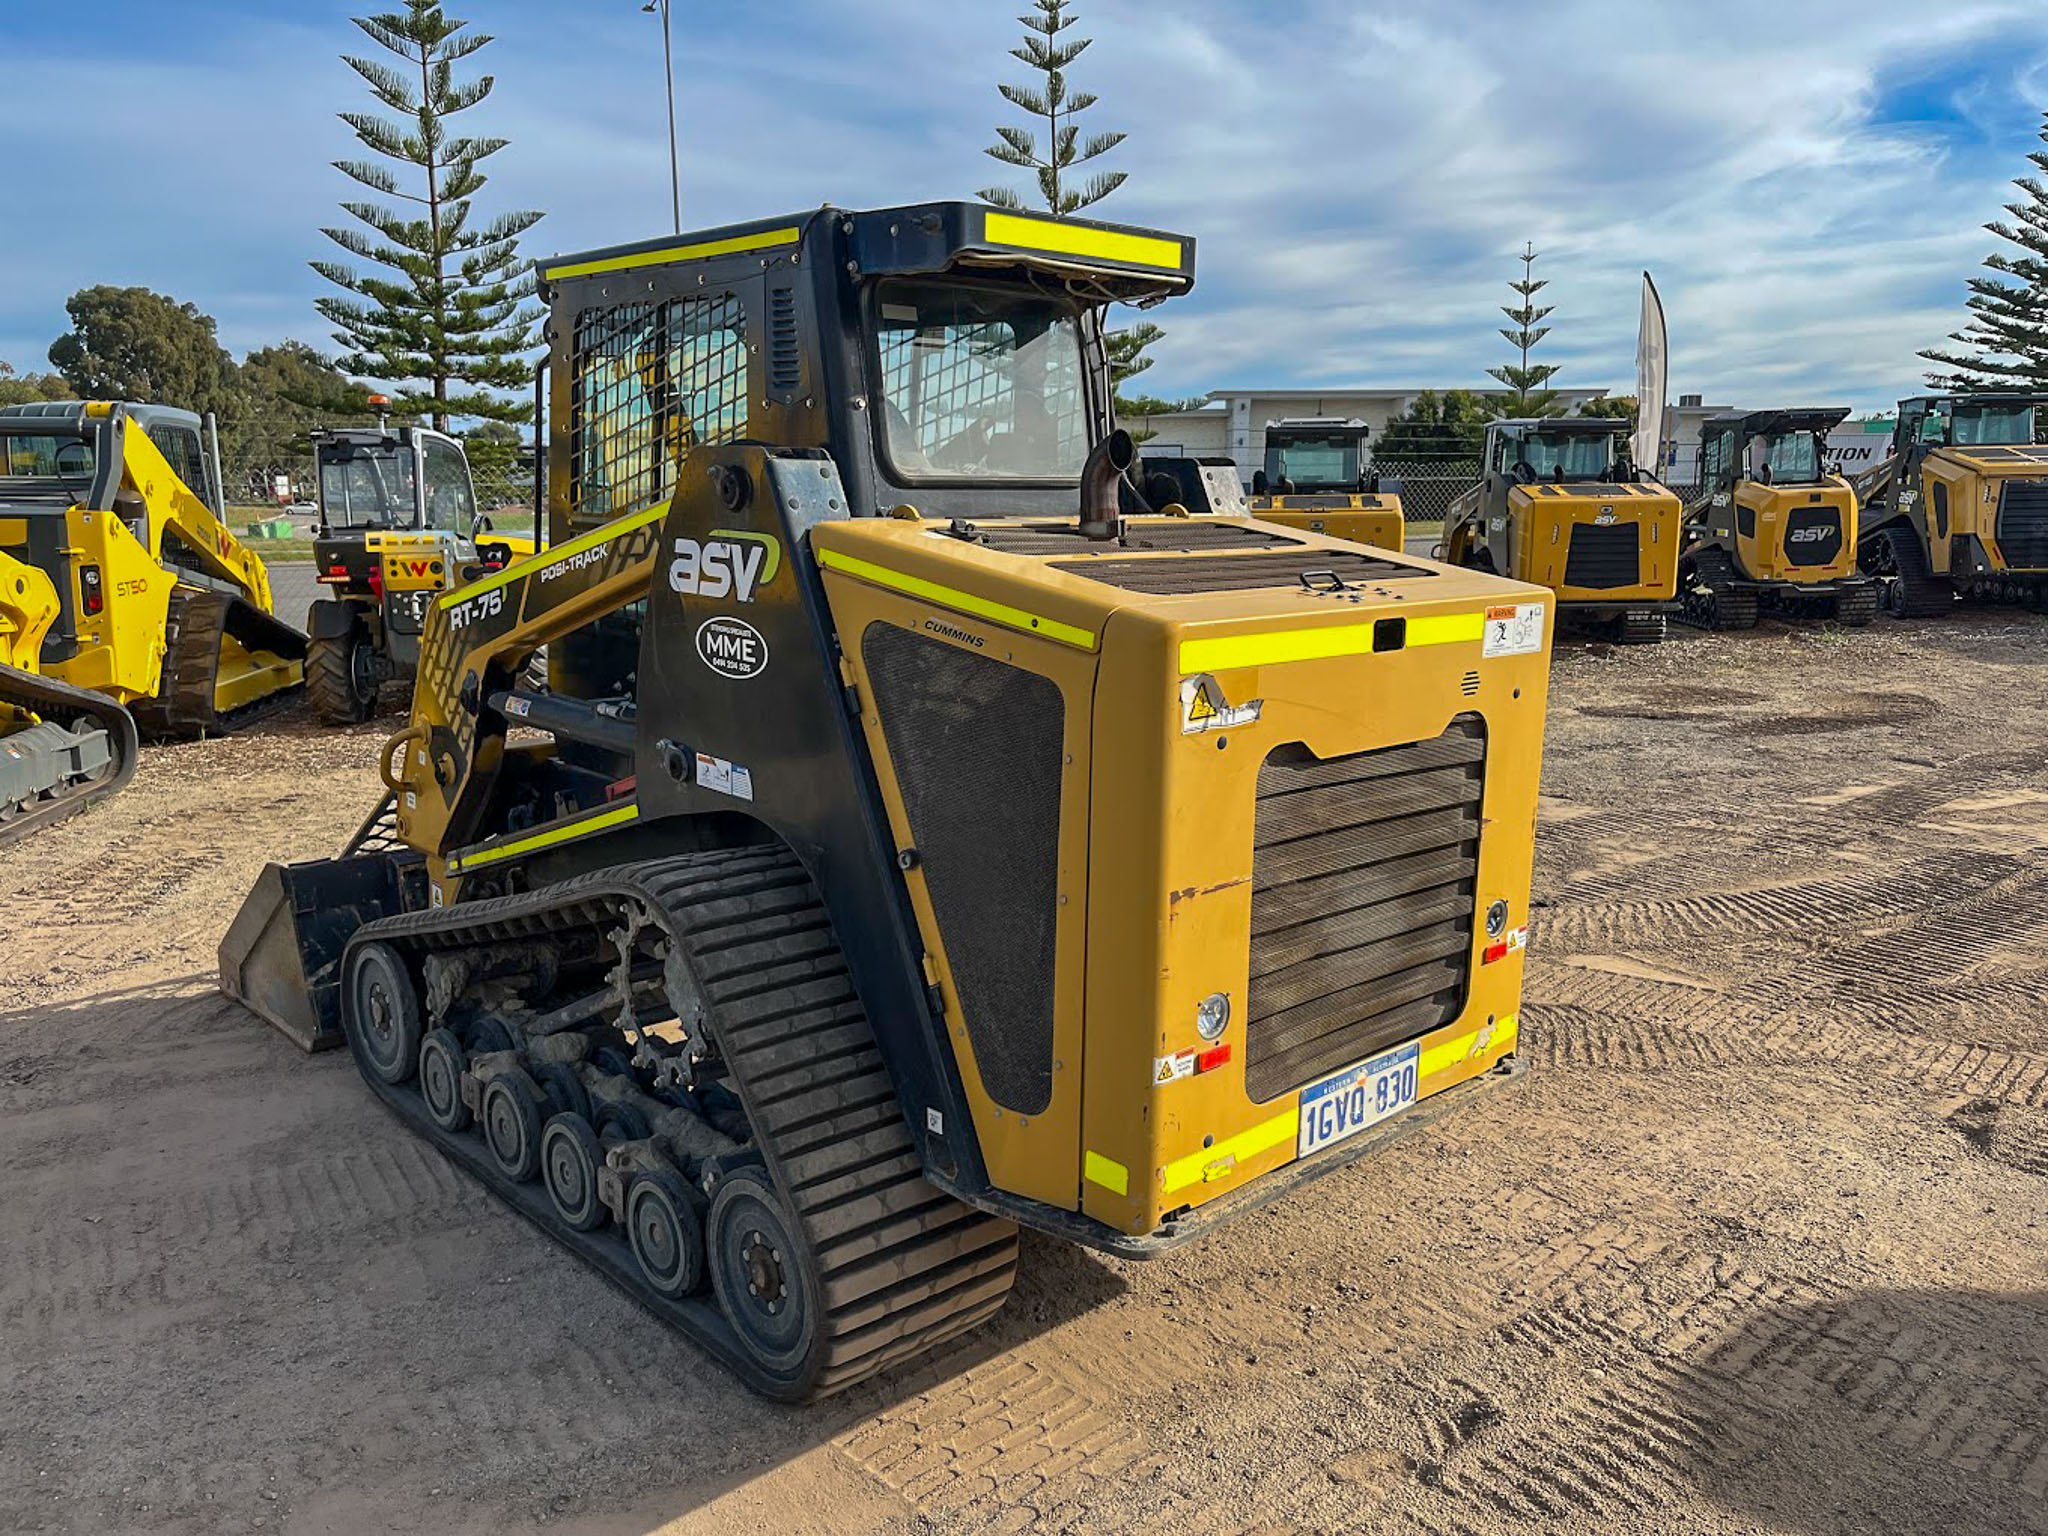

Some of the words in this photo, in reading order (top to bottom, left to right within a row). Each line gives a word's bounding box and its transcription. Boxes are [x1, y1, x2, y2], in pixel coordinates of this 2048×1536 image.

[1791, 526, 1832, 542] asv
[541, 543, 608, 583] POSI-TRACK
[669, 536, 765, 602] asv
[117, 578, 148, 597] ST50
[451, 590, 502, 631] RT-75
[706, 632, 756, 663] MME
[925, 620, 984, 648] CUMMINS
